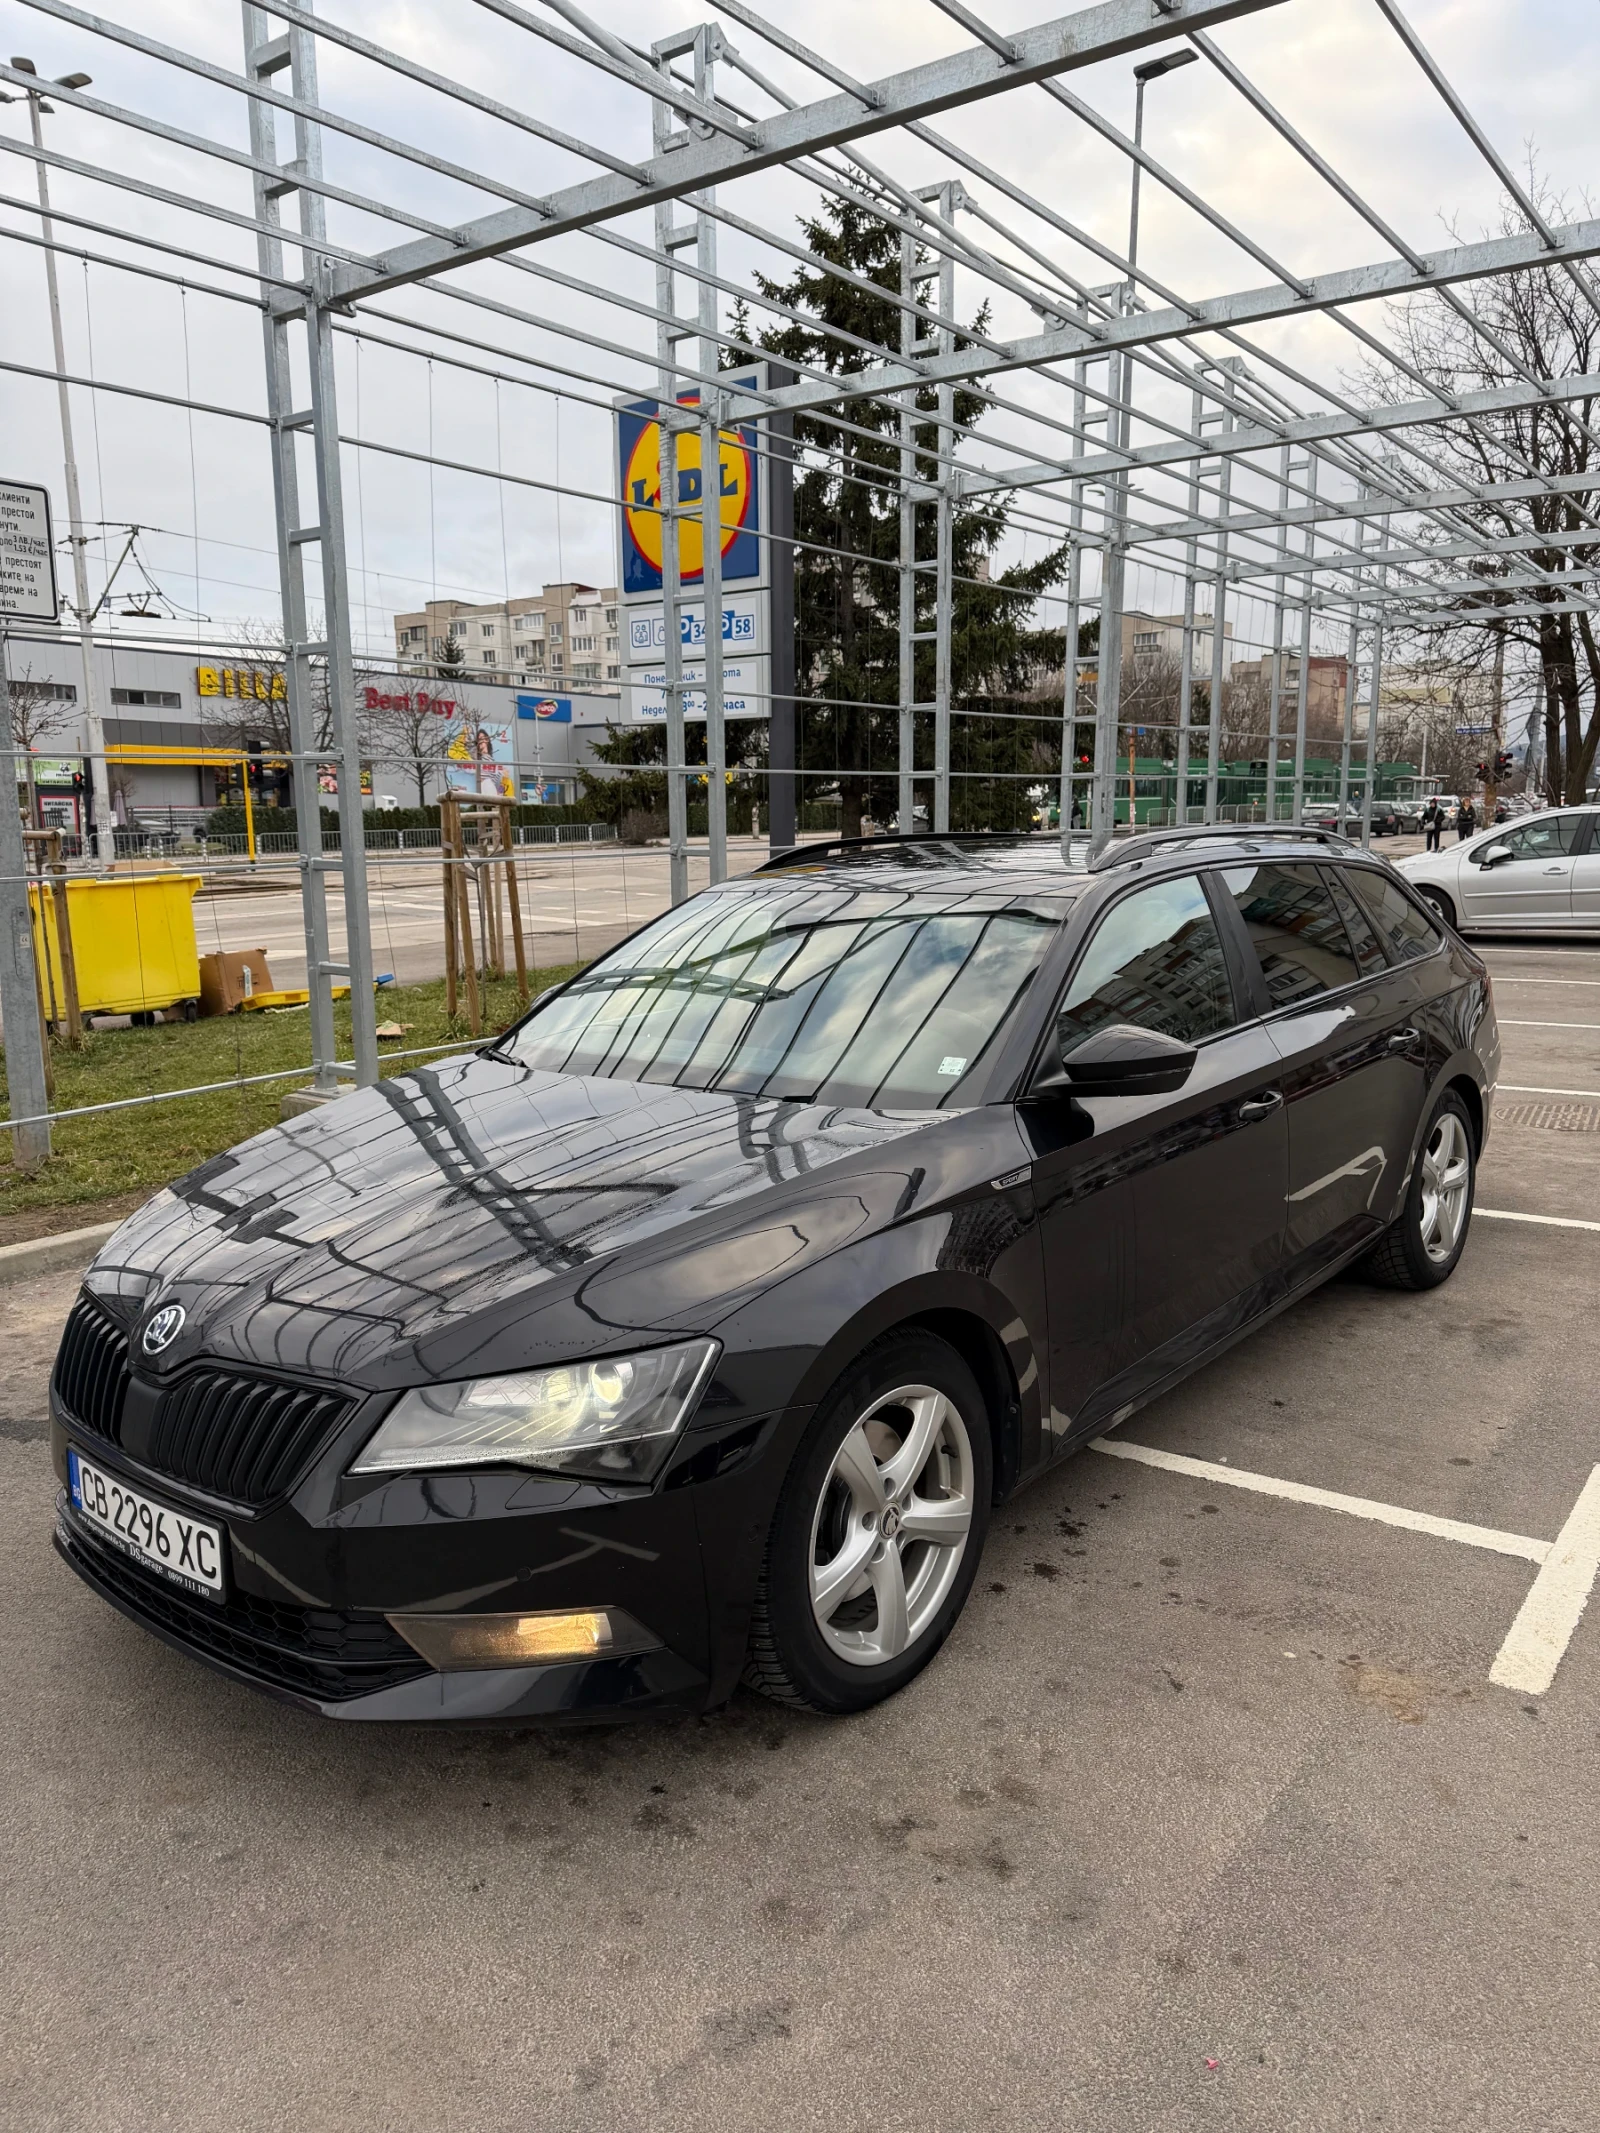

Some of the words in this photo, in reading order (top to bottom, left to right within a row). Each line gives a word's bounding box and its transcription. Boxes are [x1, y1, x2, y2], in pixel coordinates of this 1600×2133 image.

[631, 462, 738, 513] LDL
[1, 506, 35, 520] престой
[14, 544, 27, 553] 1.53
[5, 556, 42, 570] престоят
[24, 573, 35, 583] на
[28, 588, 38, 597] на
[735, 618, 751, 634] 58
[197, 666, 288, 700] BILLA
[364, 687, 411, 711] Best
[416, 692, 457, 720] Buy
[72, 1484, 81, 1500] BG
[82, 1466, 109, 1520] CB
[111, 1486, 171, 1558] 2296
[175, 1519, 217, 1580] XC
[184, 1578, 196, 1591] 111
[197, 1584, 210, 1597] 180
